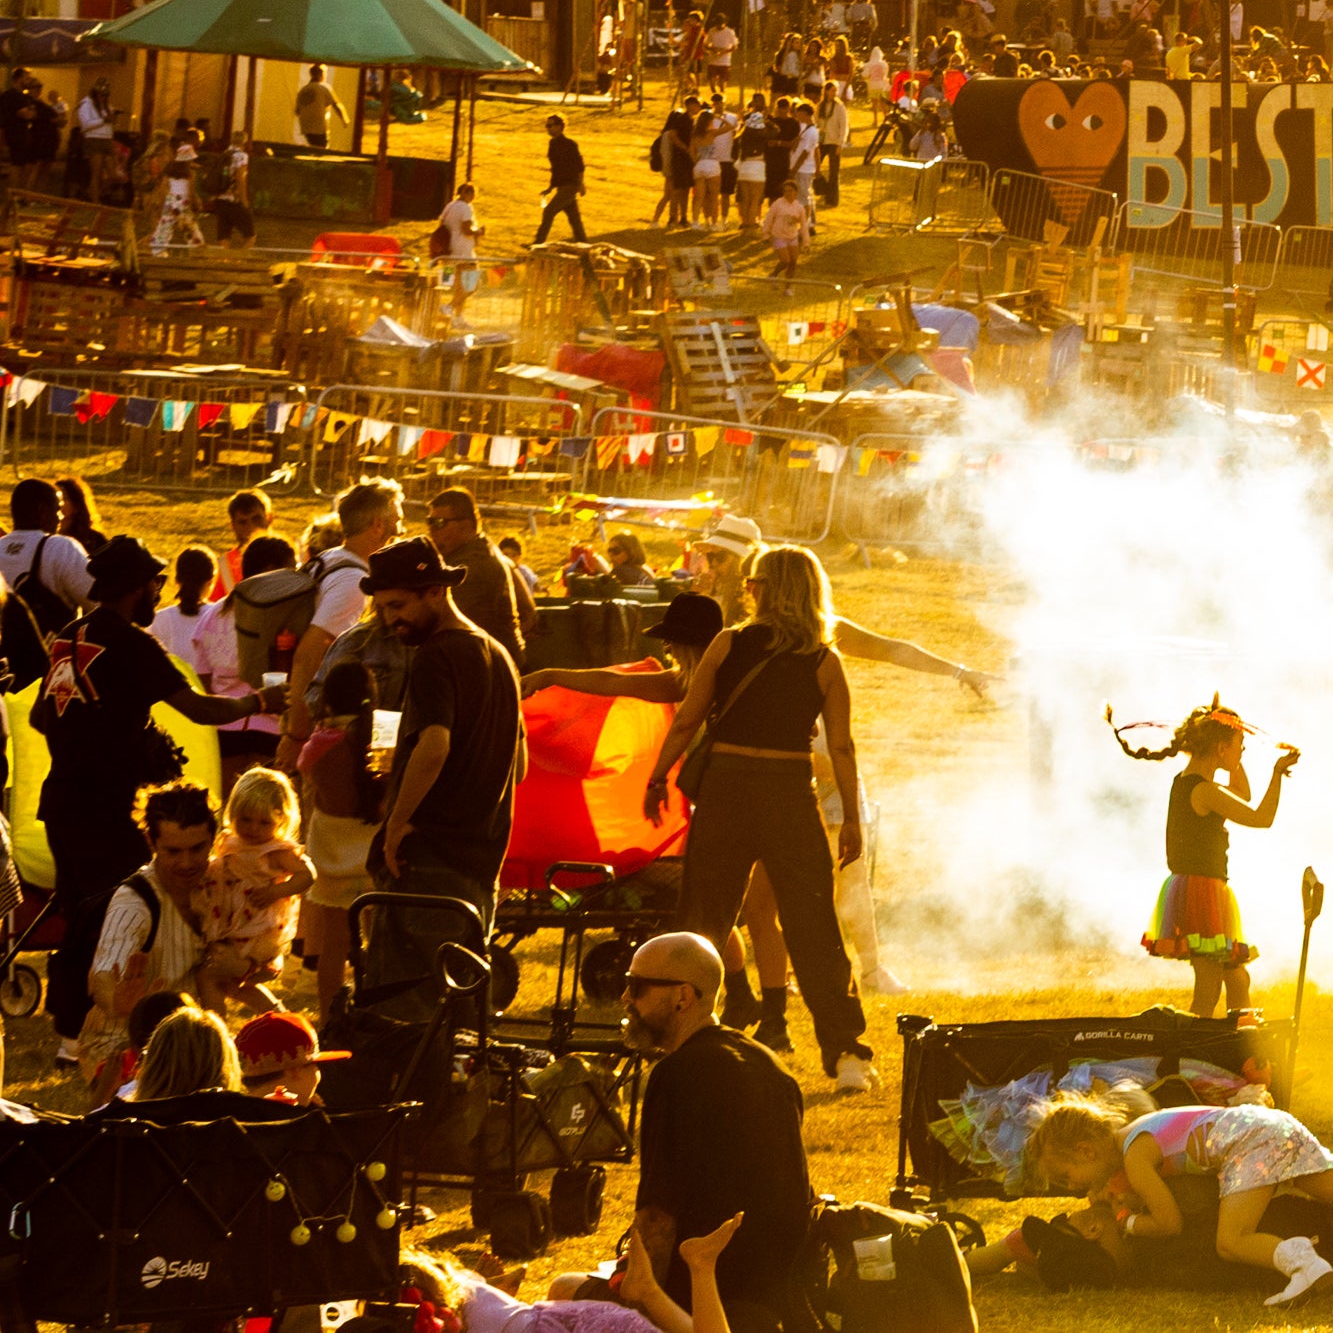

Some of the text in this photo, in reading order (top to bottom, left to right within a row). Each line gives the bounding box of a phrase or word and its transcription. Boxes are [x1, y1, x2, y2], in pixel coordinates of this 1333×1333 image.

[1085, 1031, 1154, 1042] GORILLA CARTS
[166, 1259, 210, 1280] Sekey
